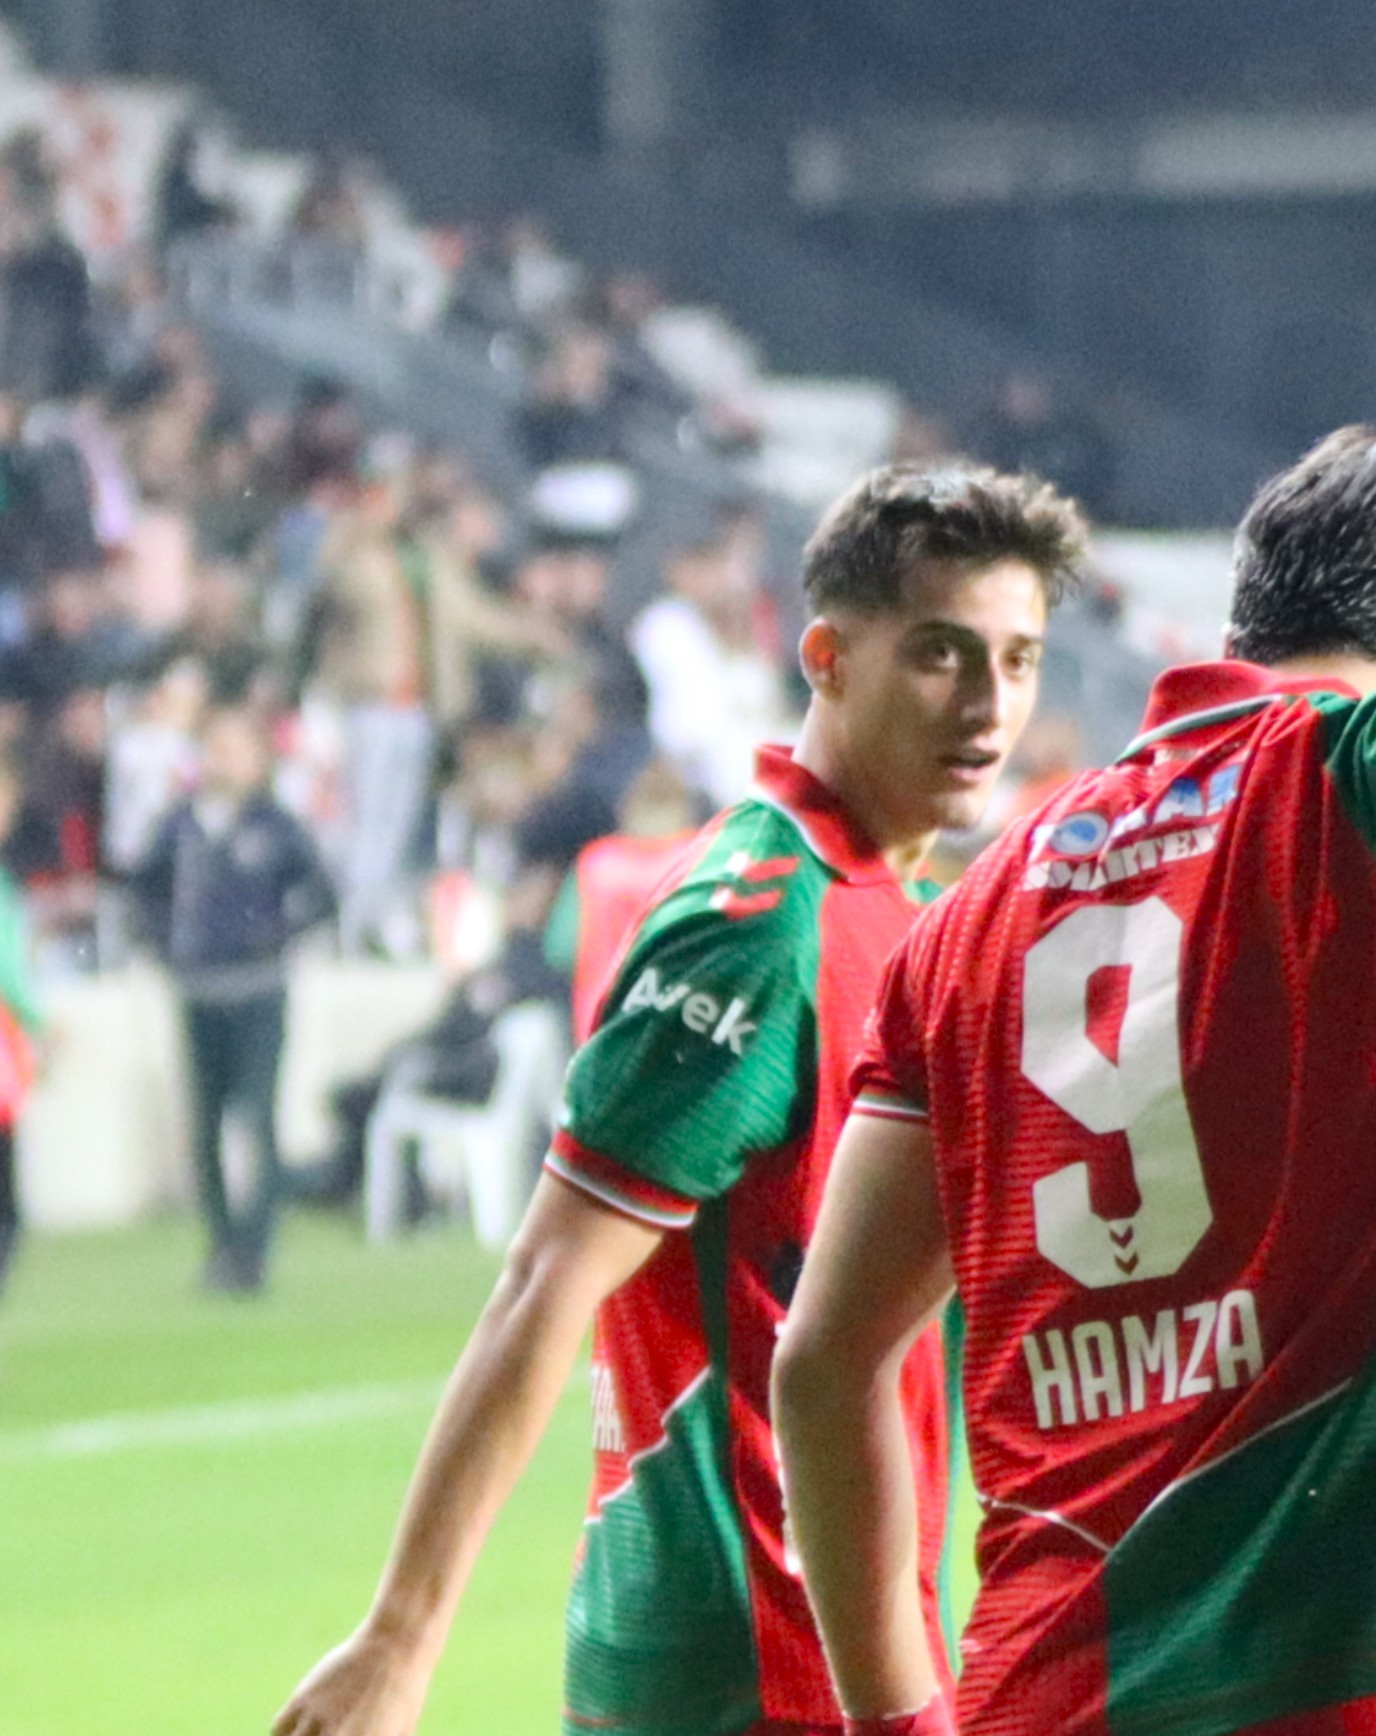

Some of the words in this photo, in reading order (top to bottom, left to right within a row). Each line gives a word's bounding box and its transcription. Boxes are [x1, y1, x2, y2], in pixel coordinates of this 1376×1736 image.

[621, 967, 757, 1057] Avek
[1020, 894, 1213, 1290] 9
[1021, 1289, 1265, 1430] HAMZA
